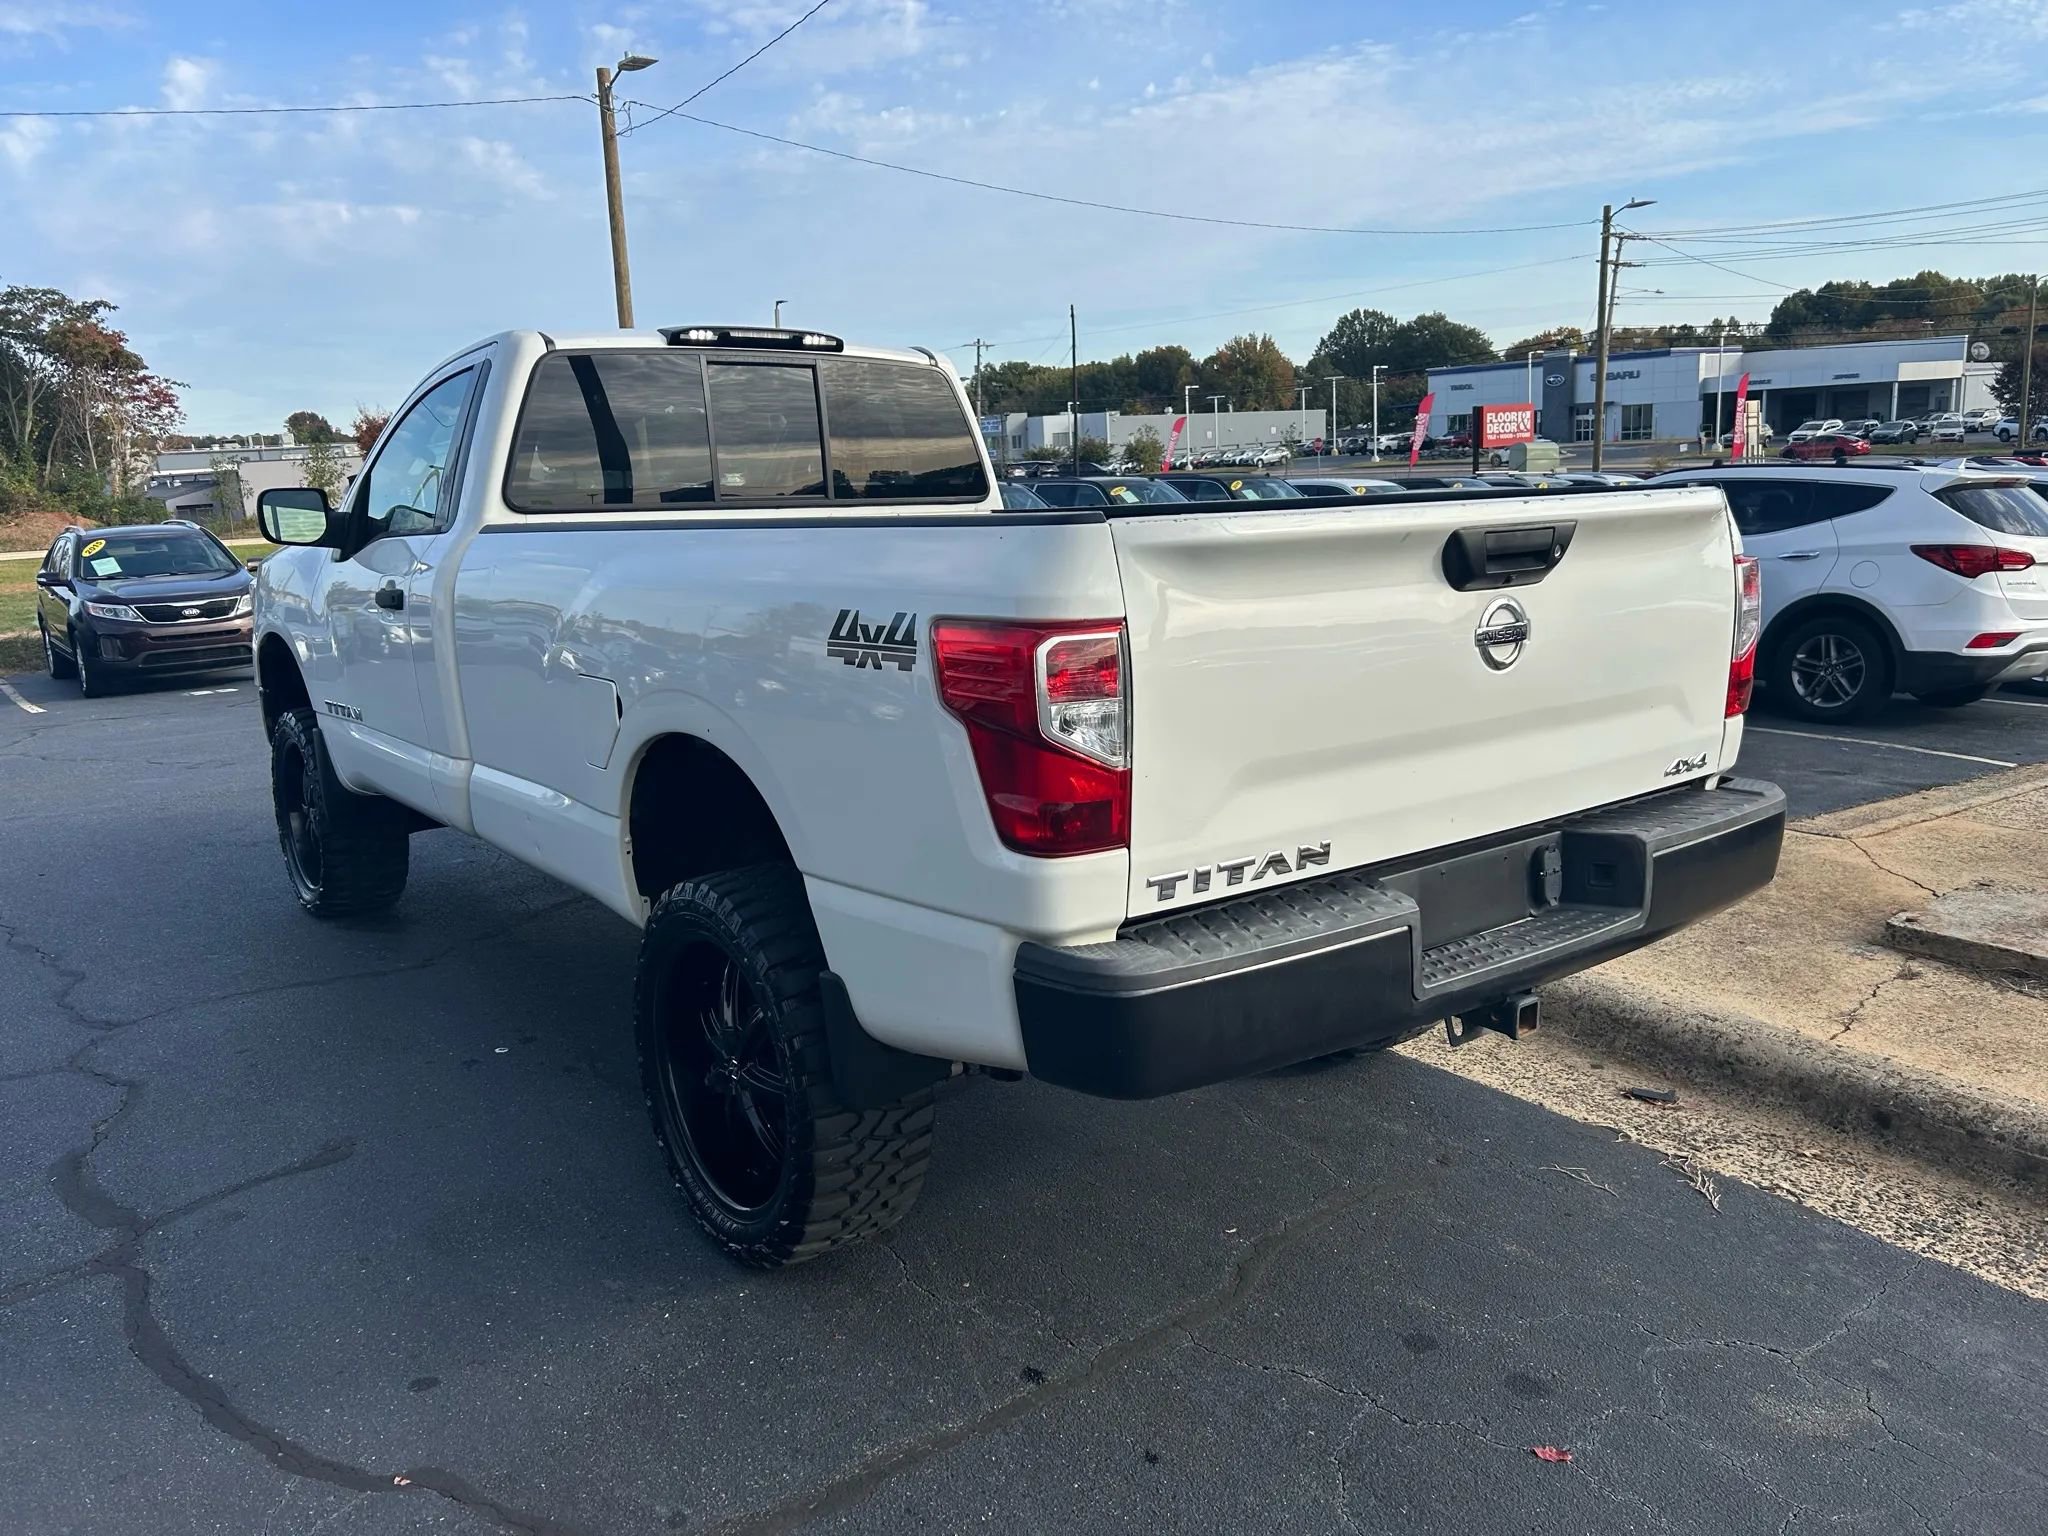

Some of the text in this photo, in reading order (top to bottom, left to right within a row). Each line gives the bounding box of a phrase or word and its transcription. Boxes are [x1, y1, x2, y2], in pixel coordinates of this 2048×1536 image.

[1590, 370, 1640, 382] SBARU
[1486, 411, 1517, 424] FLOOR
[1486, 422, 1517, 434] DECOR
[1483, 624, 1526, 644] NISSAN
[324, 699, 363, 722] TITAN
[1146, 839, 1331, 902] TITAN
